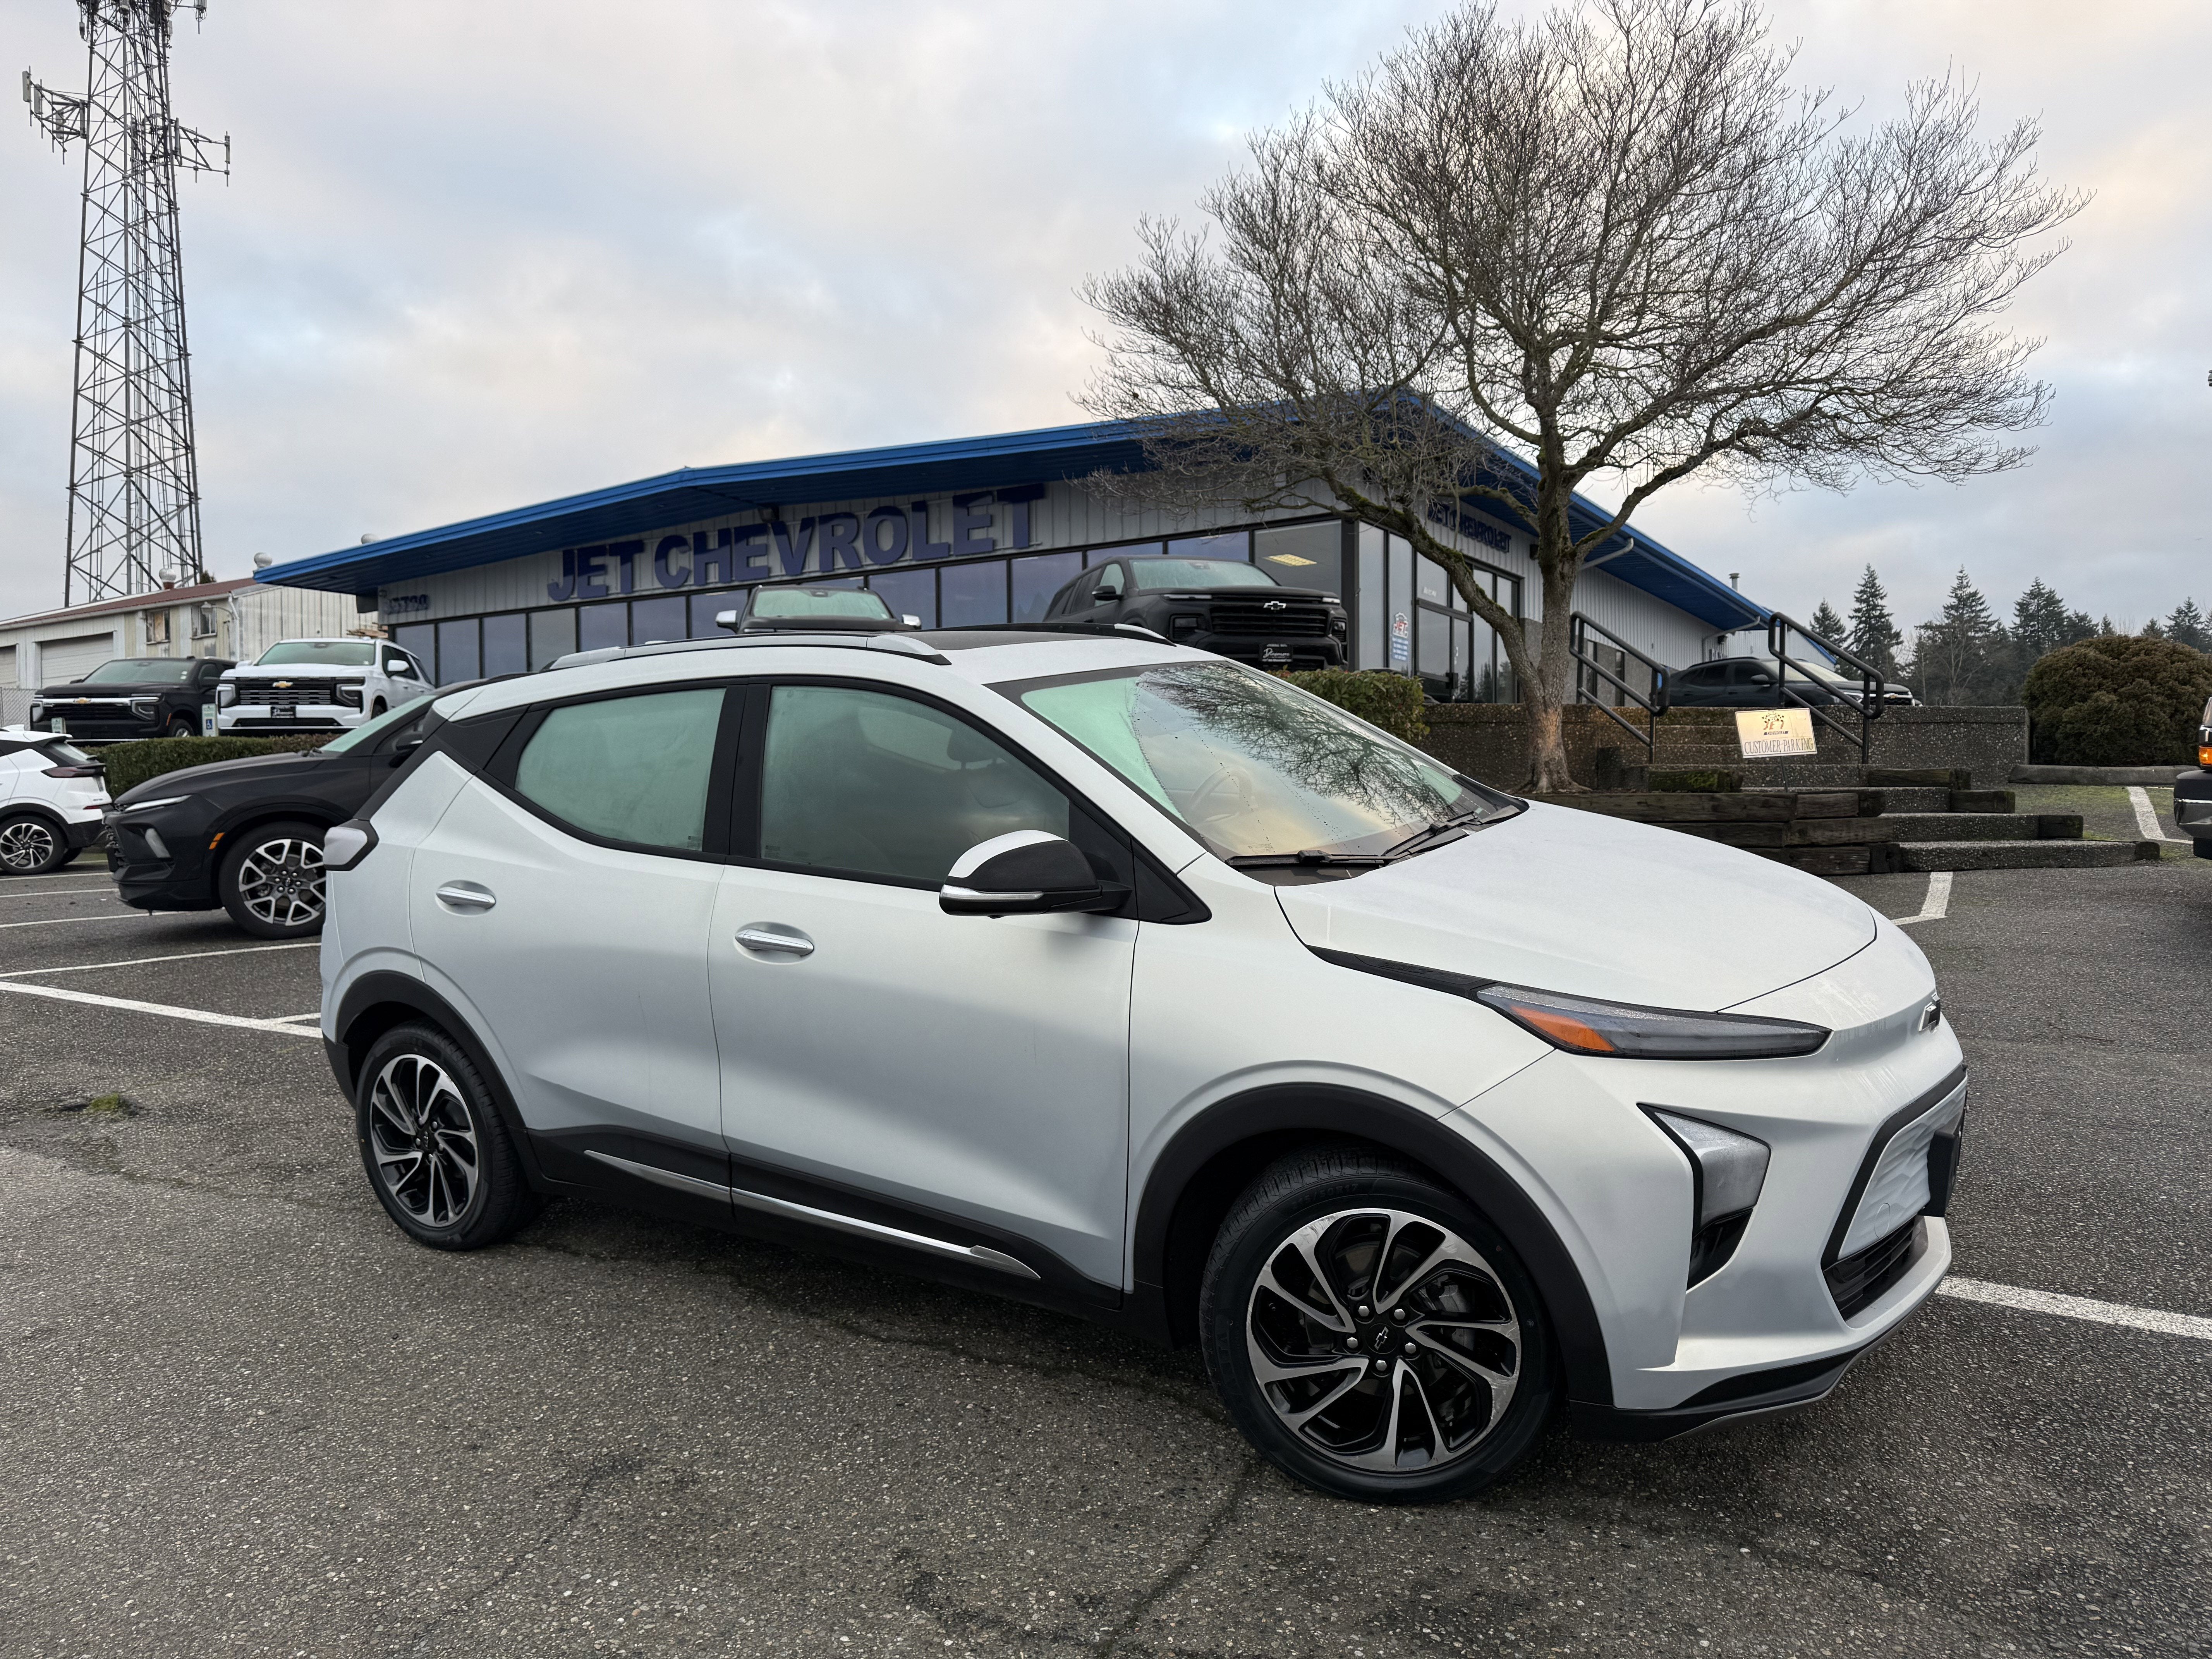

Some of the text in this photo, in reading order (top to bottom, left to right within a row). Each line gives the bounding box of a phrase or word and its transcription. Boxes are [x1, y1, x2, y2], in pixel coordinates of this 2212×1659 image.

[1427, 502, 1450, 525] JET
[547, 483, 1044, 602] JET CHEVROLET
[1394, 620, 1408, 632] JET
[1763, 720, 1784, 730] JET
[1744, 738, 1813, 754] CUSTOMER PARKING
